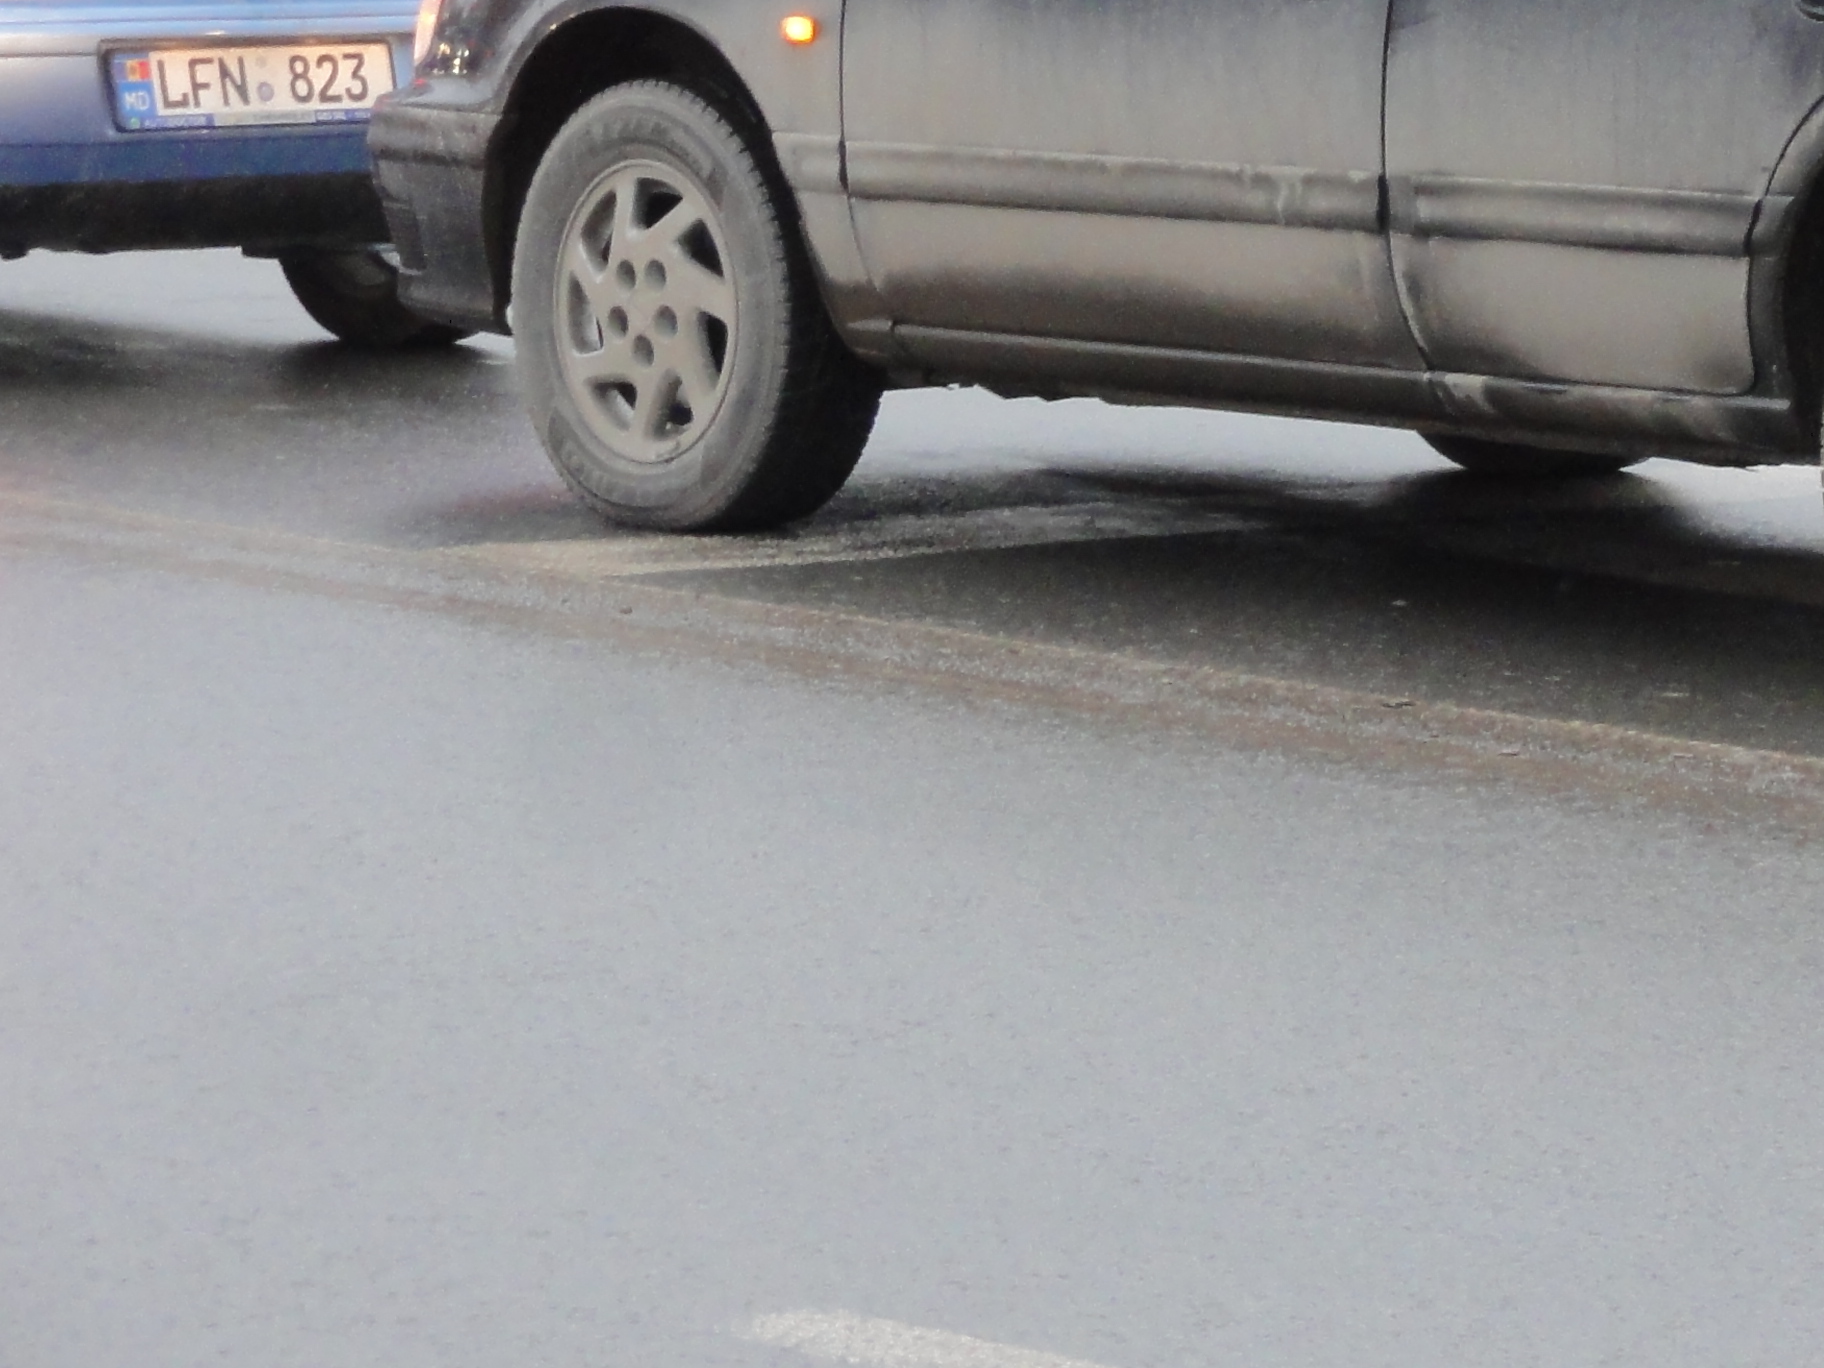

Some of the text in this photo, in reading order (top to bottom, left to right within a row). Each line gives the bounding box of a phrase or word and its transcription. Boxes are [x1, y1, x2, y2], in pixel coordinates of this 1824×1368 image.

[157, 52, 370, 109] LFN 823
[123, 90, 150, 112] MD
